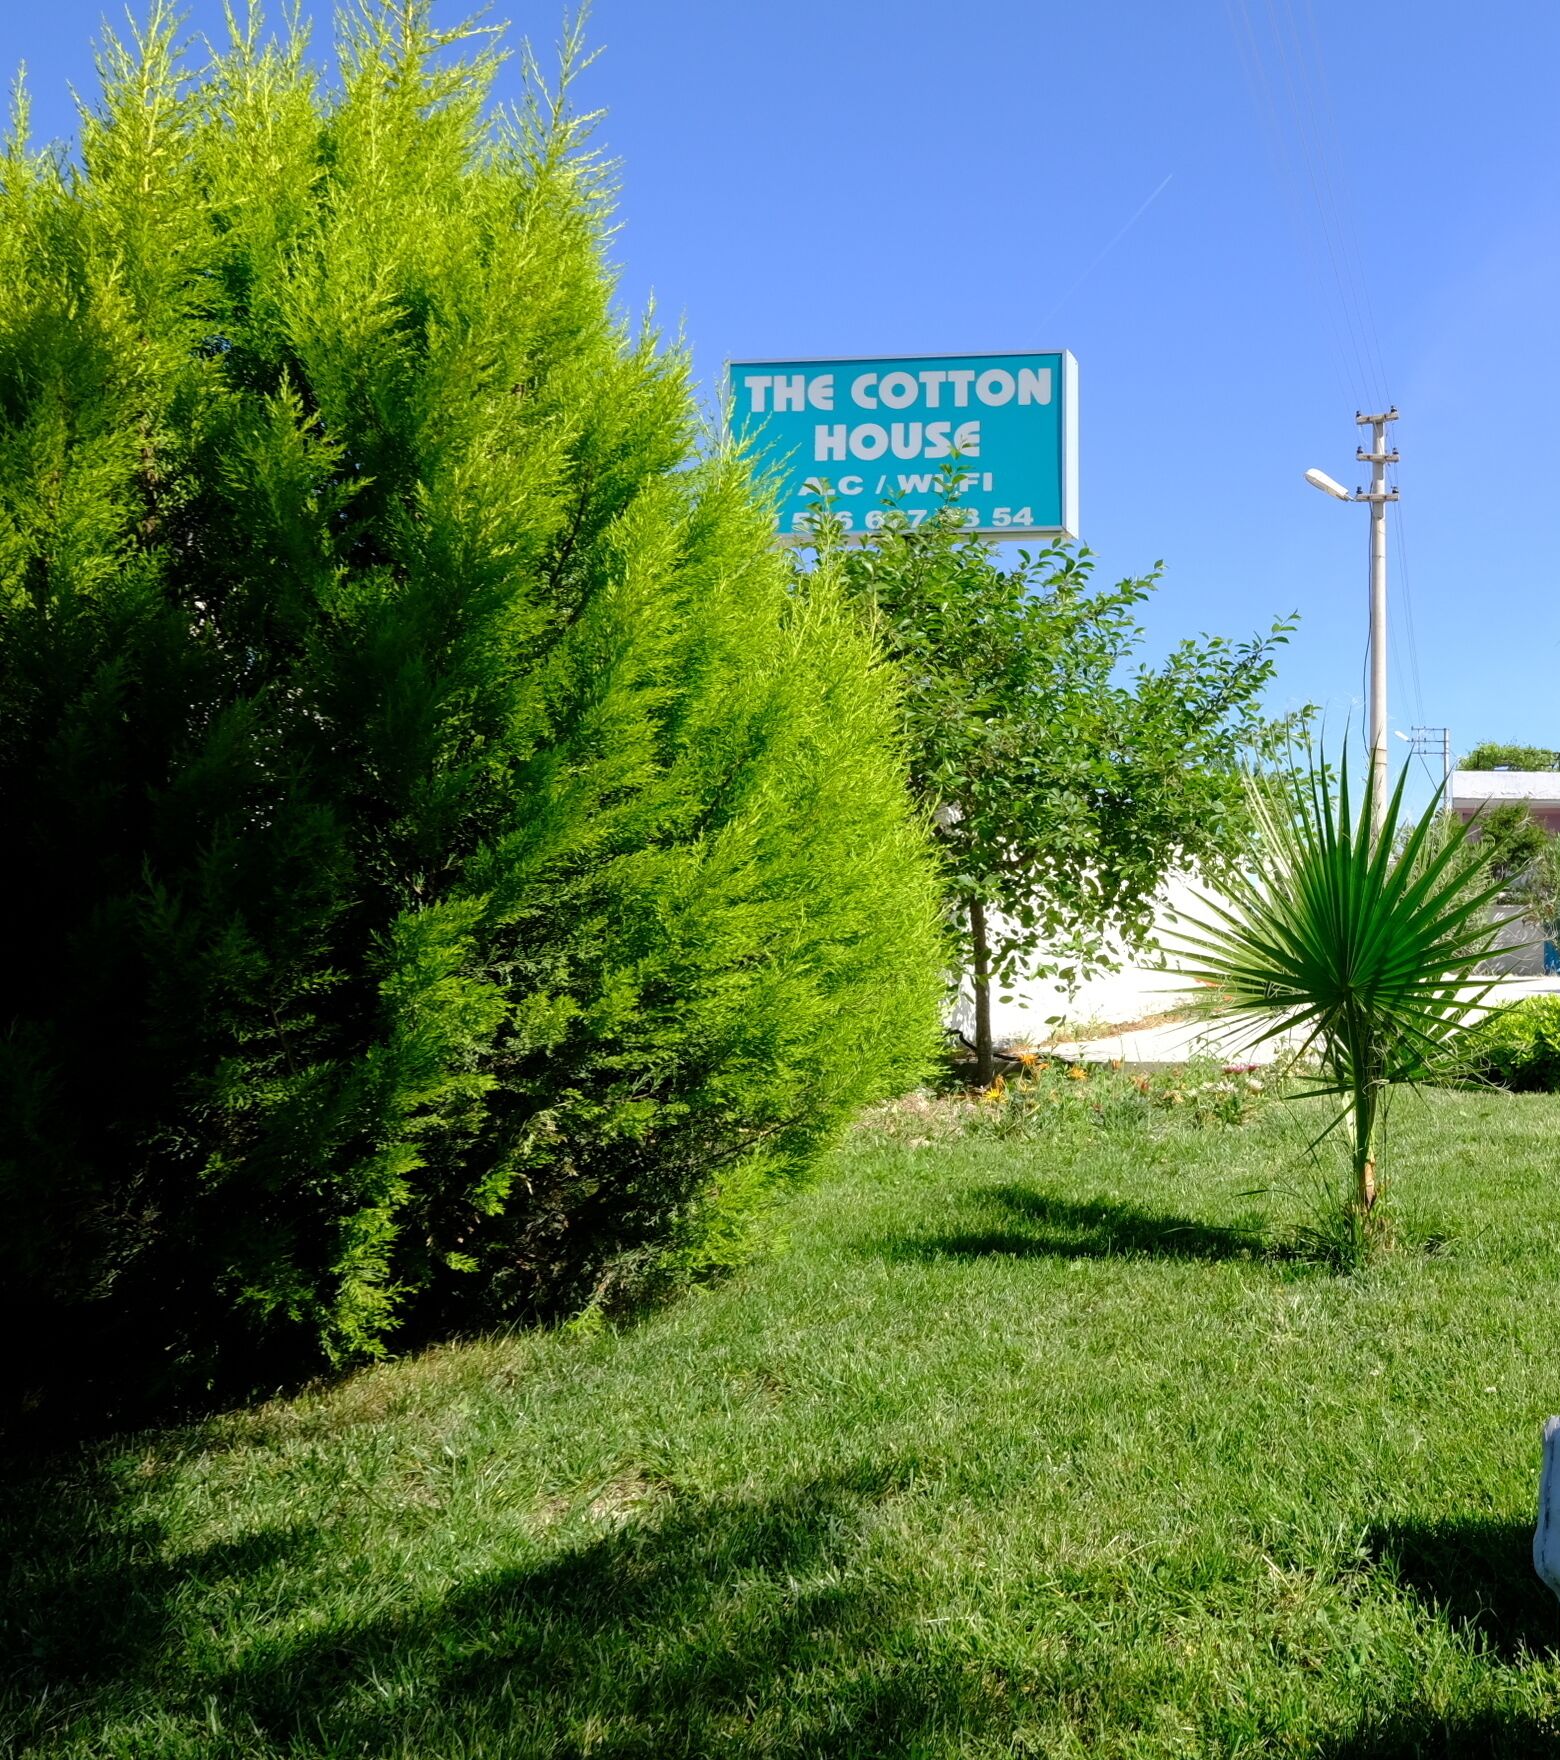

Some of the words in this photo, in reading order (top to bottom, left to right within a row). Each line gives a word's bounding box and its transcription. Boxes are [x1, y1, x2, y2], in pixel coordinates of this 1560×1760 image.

[744, 374, 834, 412] THE
[851, 368, 1052, 410] COTTON
[814, 420, 980, 461] HOUSE
[897, 472, 993, 495] WIFI
[792, 511, 853, 531] 56
[865, 509, 927, 531] 67
[992, 506, 1034, 528] 54
